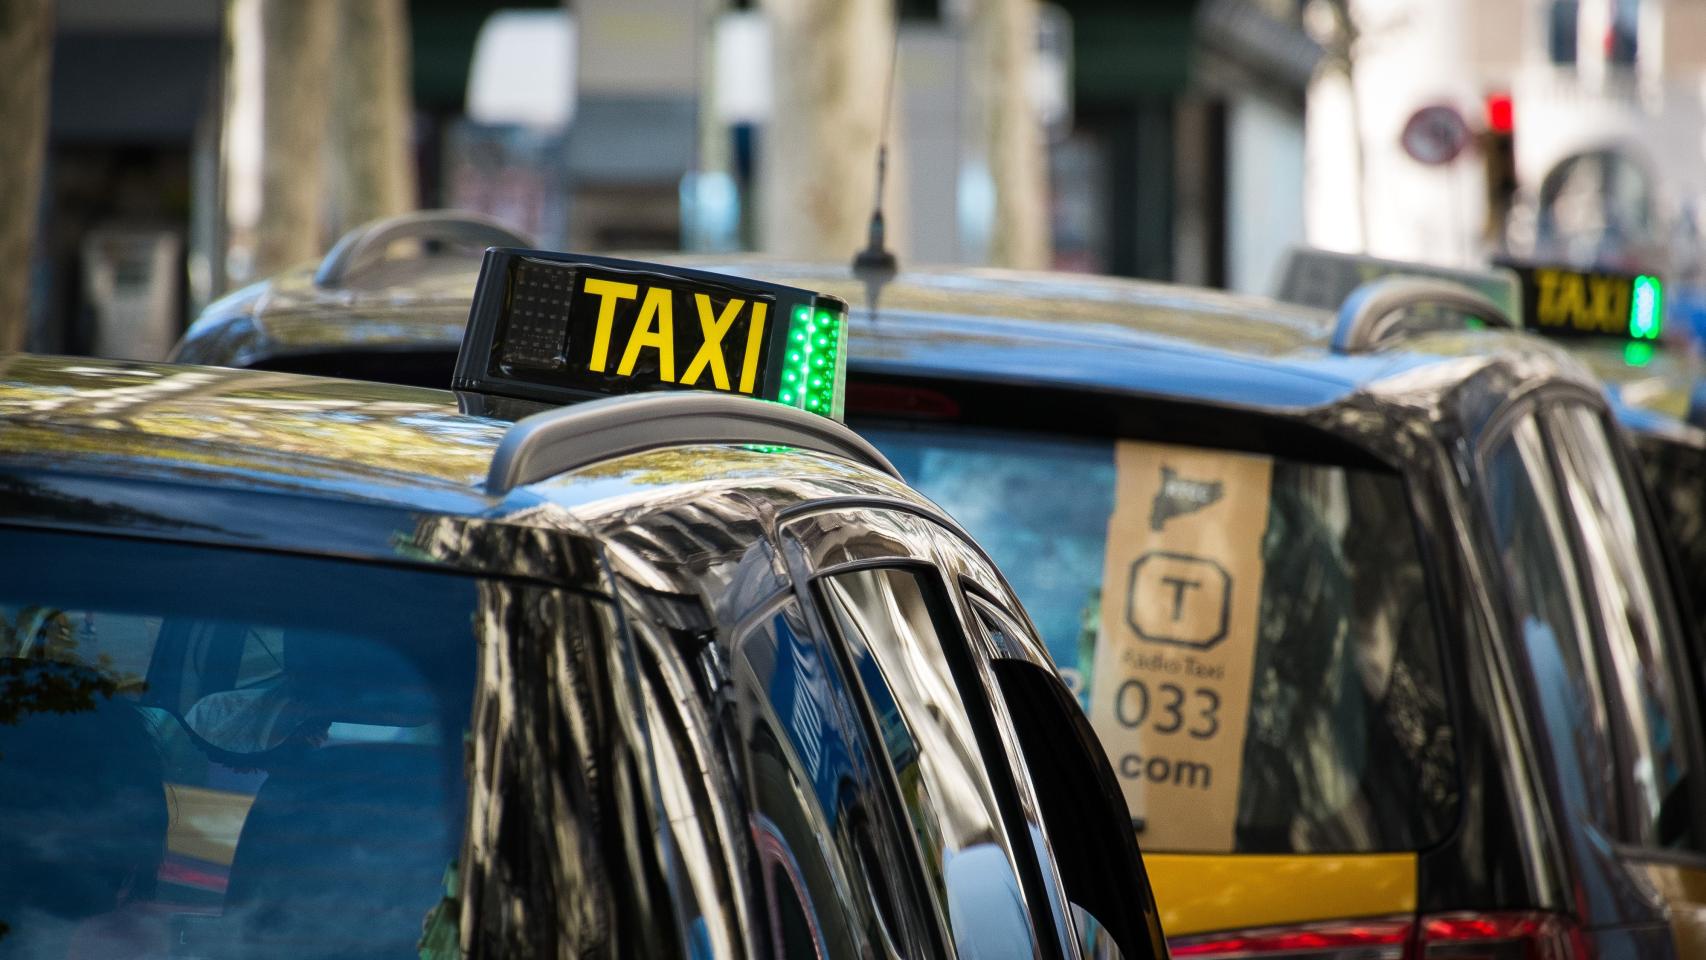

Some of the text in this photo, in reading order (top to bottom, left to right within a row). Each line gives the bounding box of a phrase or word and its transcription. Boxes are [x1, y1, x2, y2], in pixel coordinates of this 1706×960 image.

[1535, 268, 1628, 333] TAXI
[583, 277, 768, 394] TAXI
[1161, 576, 1201, 622] T
[1184, 655, 1225, 679] Taxi
[1116, 679, 1220, 740] 033
[1119, 752, 1213, 790] com
